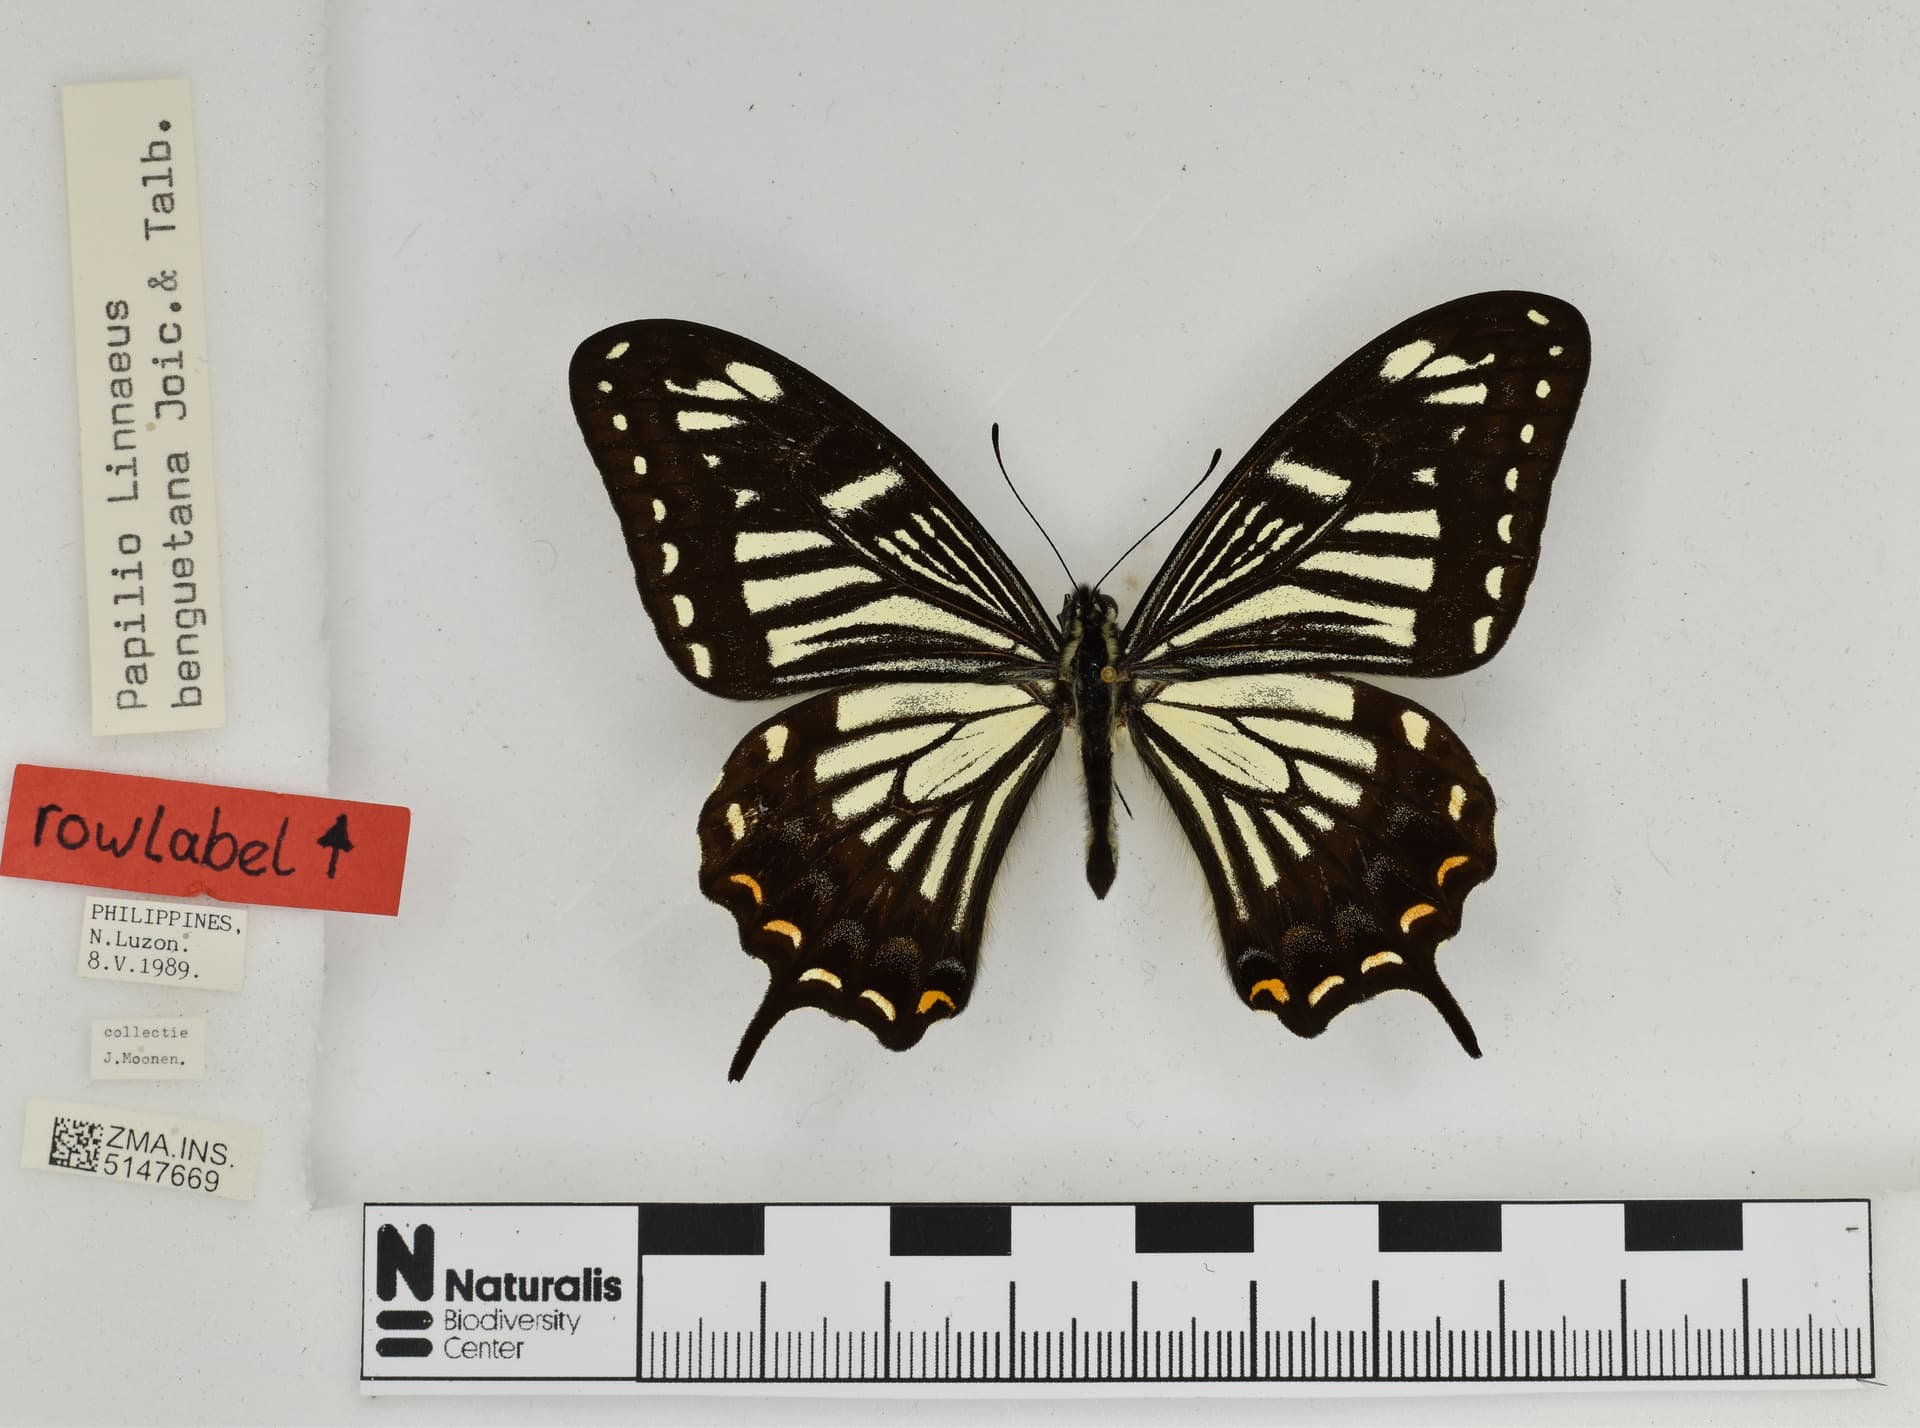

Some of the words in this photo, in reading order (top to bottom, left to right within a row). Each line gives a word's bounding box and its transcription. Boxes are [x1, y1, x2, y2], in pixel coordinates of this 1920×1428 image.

[140, 119, 176, 241] Talb.
[105, 299, 138, 502] Linnaeus
[162, 451, 206, 708] benguetana
[111, 533, 155, 710] Papilio
[34, 804, 296, 877] rowlabel
[90, 903, 241, 935] PHILIPPINES,
[89, 927, 188, 953] N.Luzon.
[87, 950, 199, 980] 8.V.1989.
[104, 1025, 189, 1039] collectie
[103, 1051, 185, 1066] J.Moonen.
[106, 1124, 235, 1168] ZMA.INS.
[103, 1152, 220, 1193] 5147669
[445, 1267, 623, 1302] Naturalis
[443, 1308, 582, 1335] Biodiversity
[443, 1336, 525, 1360] Center
